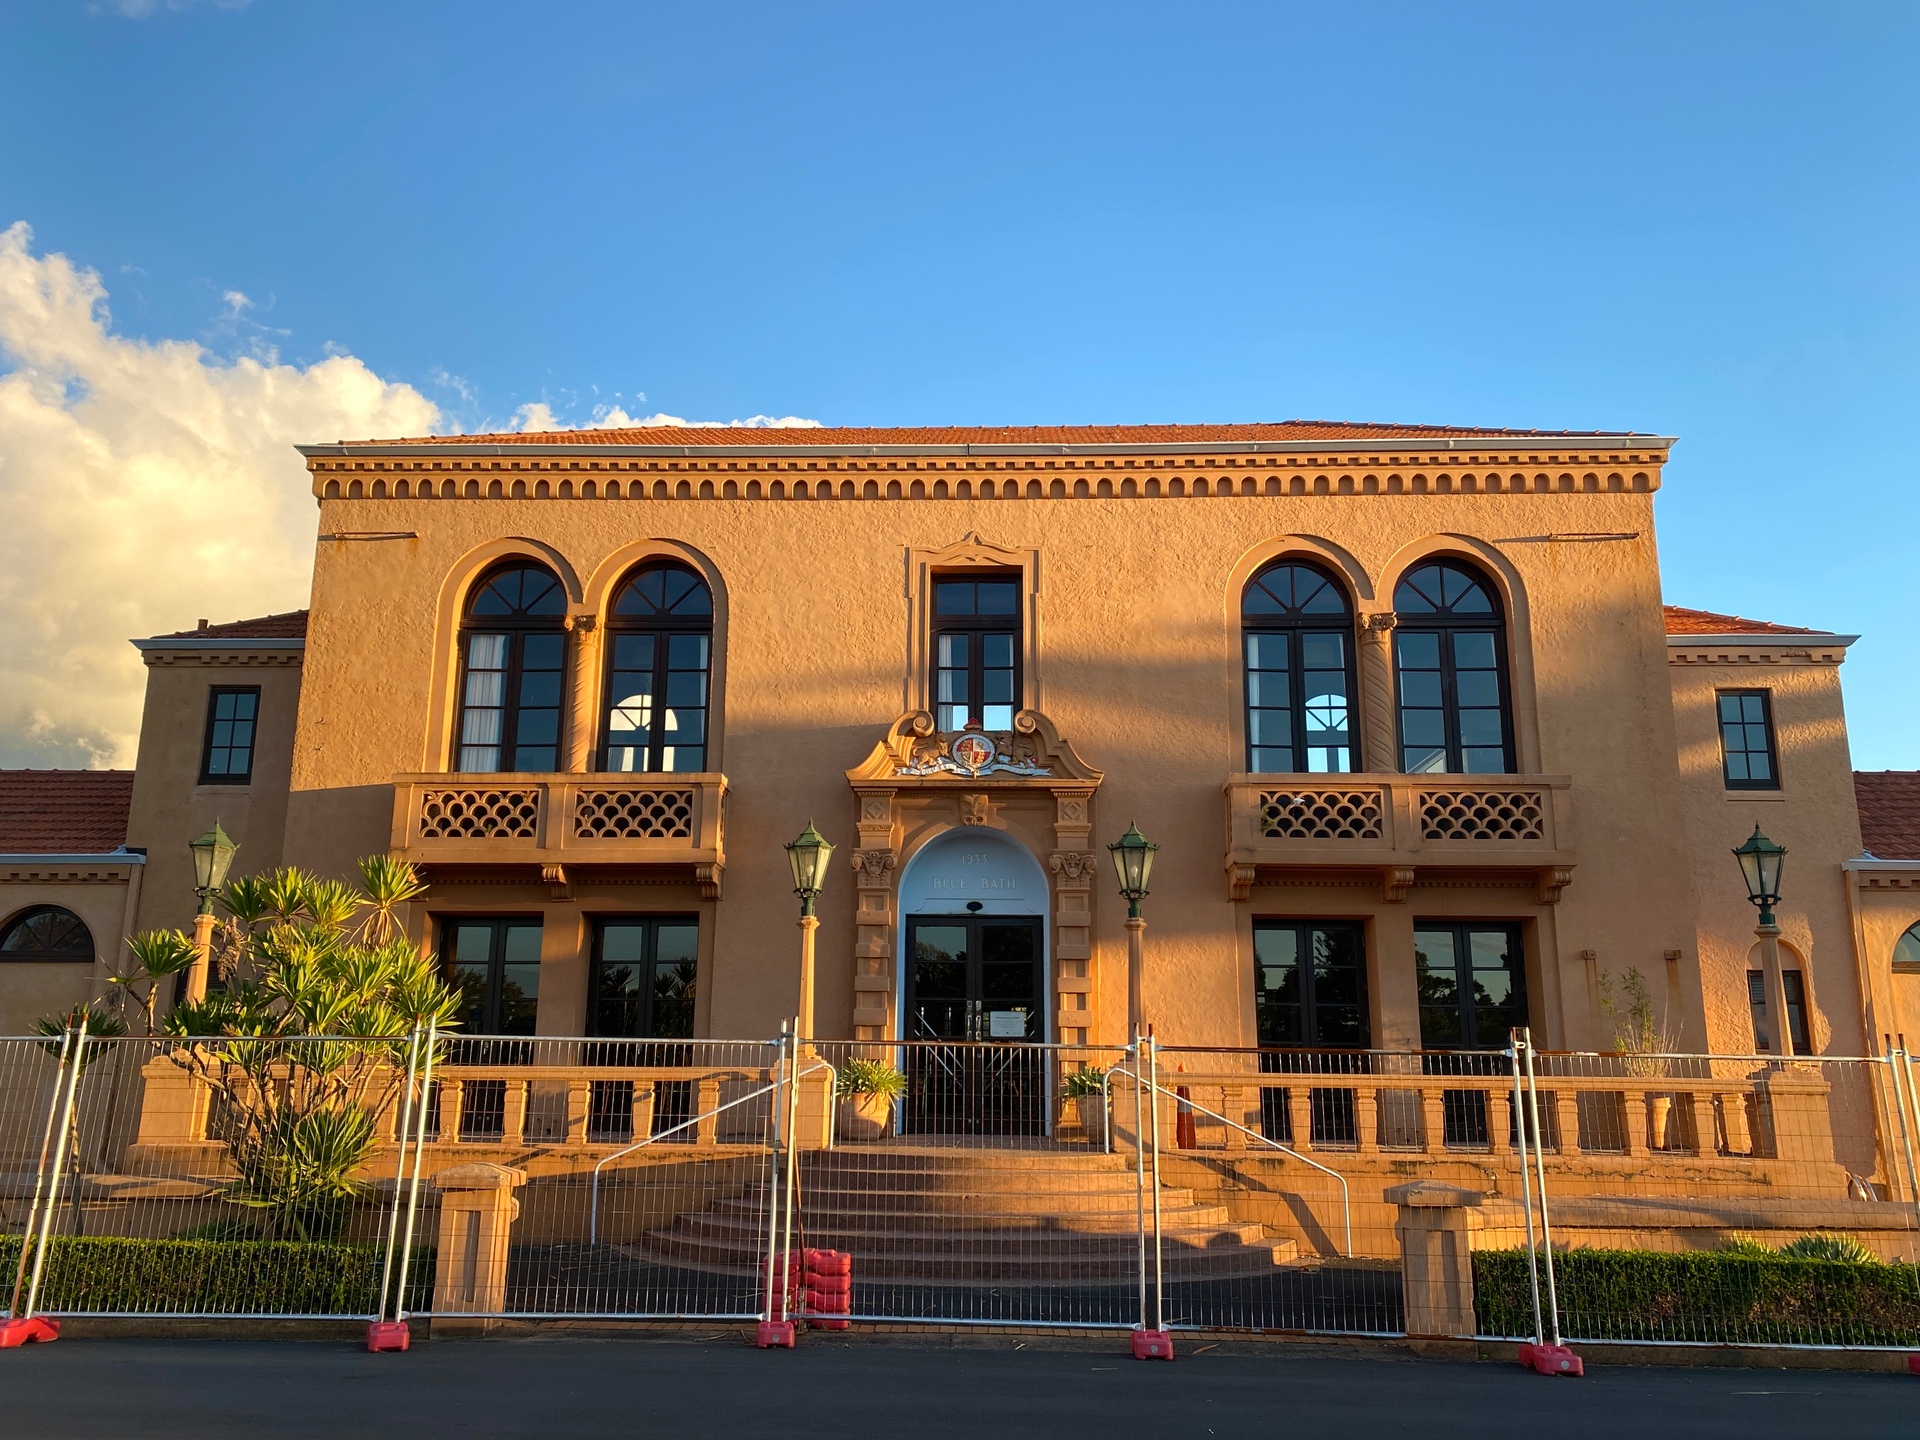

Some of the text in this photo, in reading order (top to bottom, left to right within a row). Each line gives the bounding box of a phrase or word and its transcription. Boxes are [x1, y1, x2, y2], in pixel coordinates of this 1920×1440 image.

[961, 854, 988, 865] 1933
[933, 878, 1017, 889] BLUE BATH
